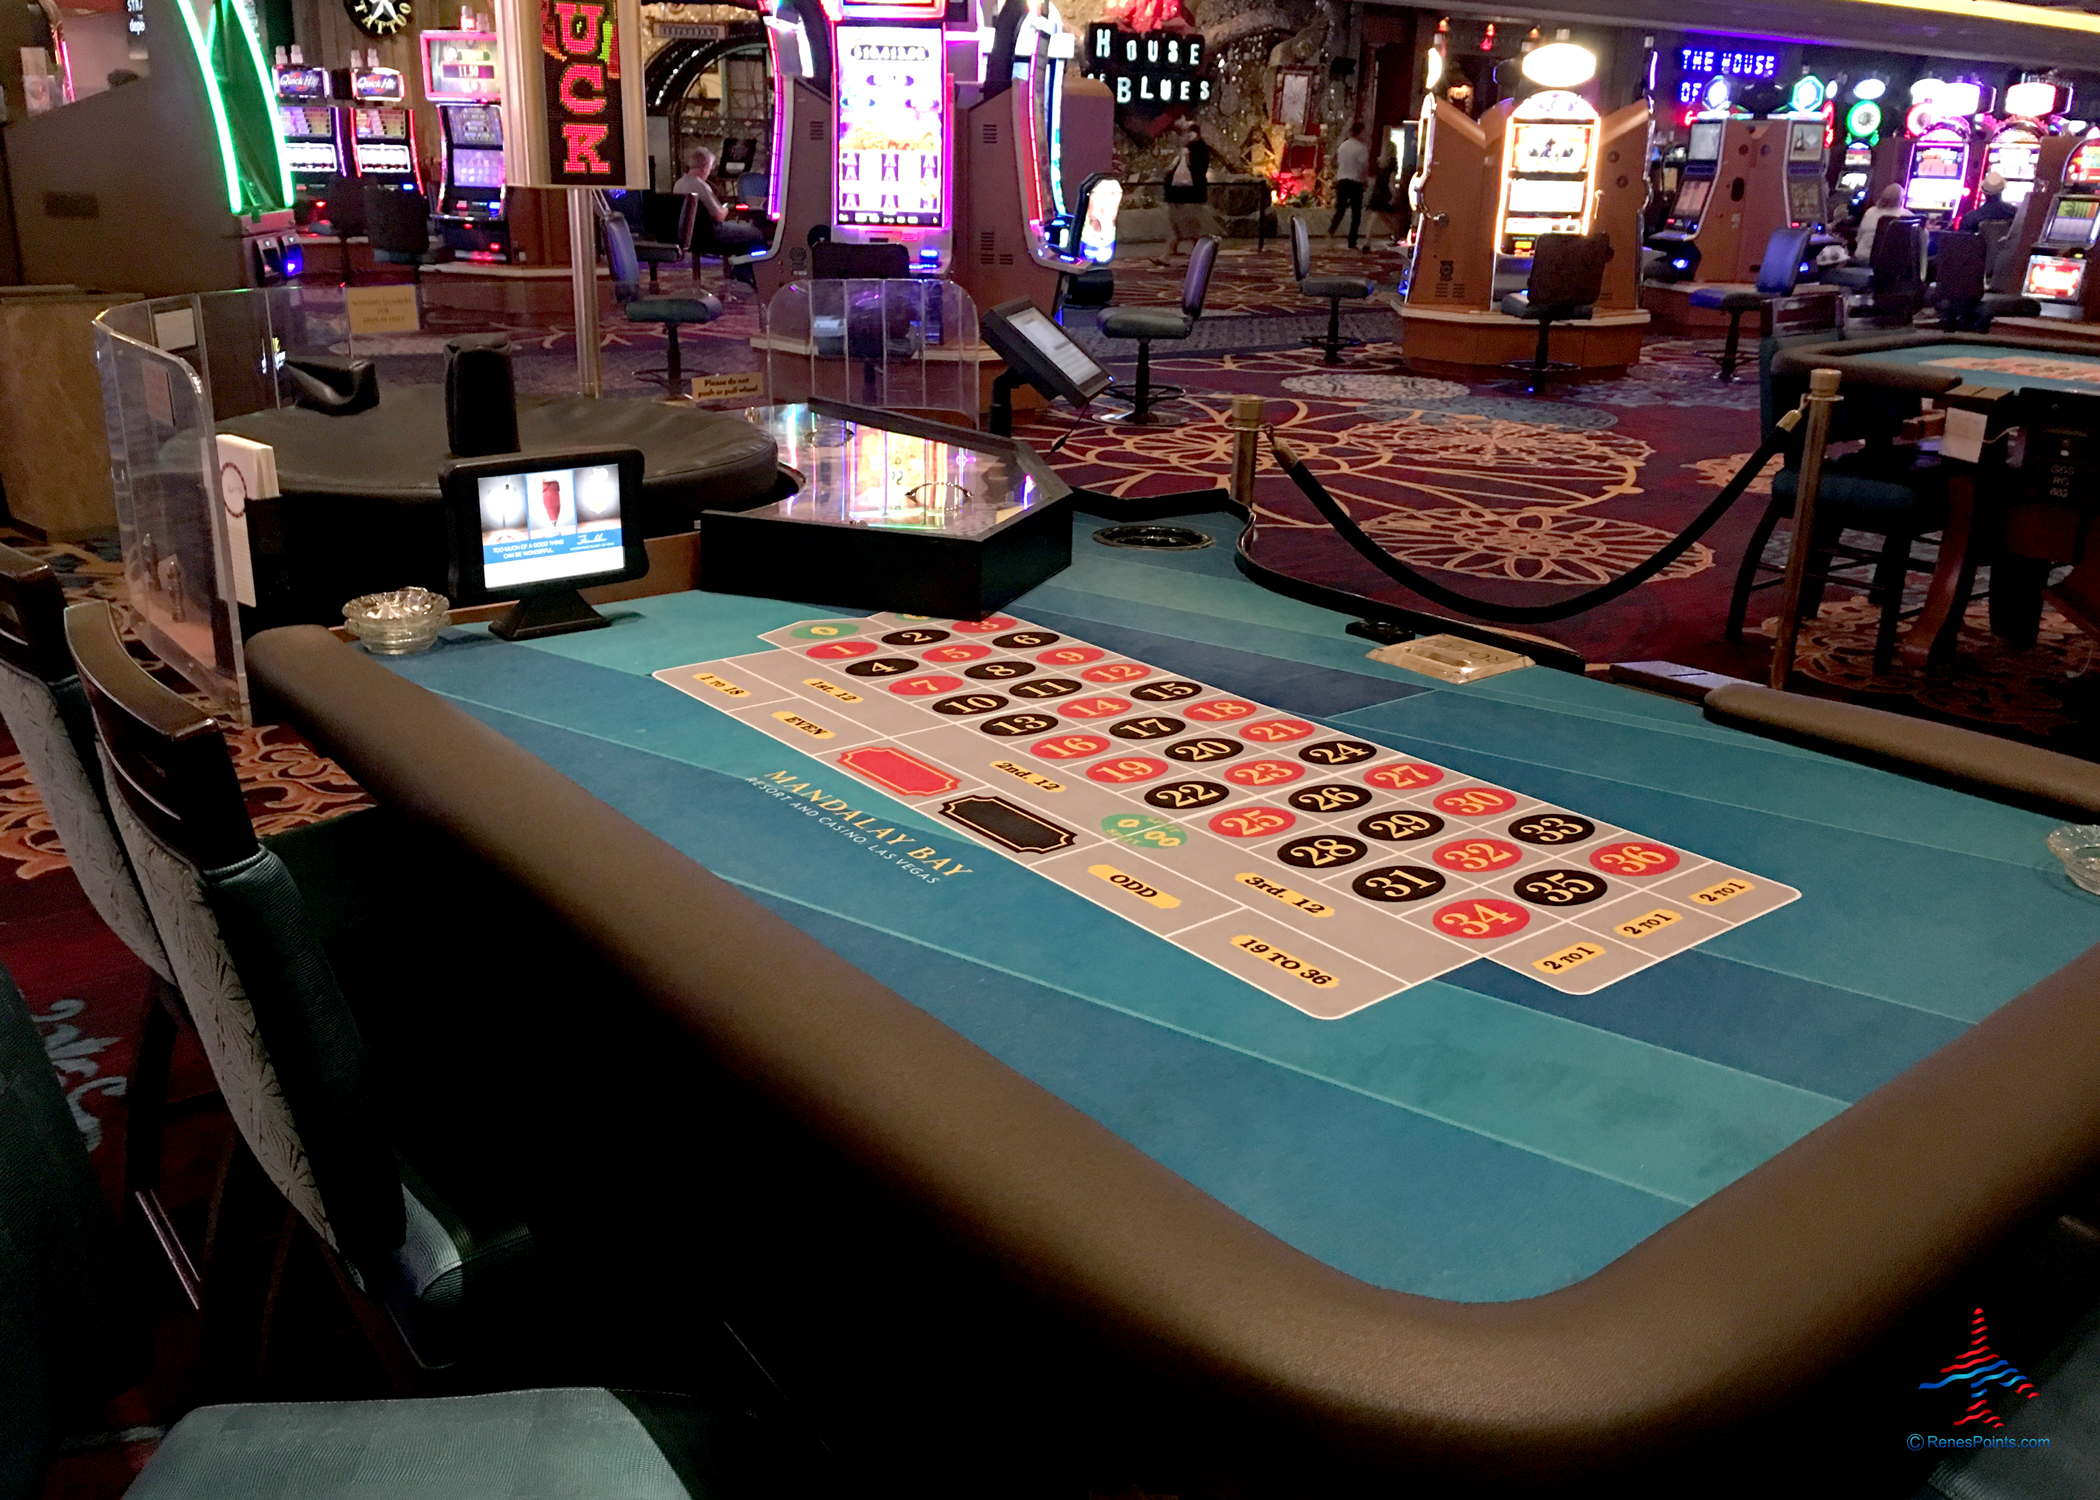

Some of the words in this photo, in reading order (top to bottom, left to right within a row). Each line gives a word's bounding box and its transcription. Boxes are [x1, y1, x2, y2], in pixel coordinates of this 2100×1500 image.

[1096, 28, 1200, 66] HOUSE
[1682, 49, 1714, 72] THE
[1721, 52, 1775, 75] HOUSE
[280, 74, 303, 86] Quick
[357, 77, 381, 89] Quick
[1117, 76, 1210, 104] BLUES
[1681, 82, 1702, 102] OF
[704, 379, 726, 387] Please
[901, 632, 932, 643] 2
[1013, 634, 1041, 645] 6
[829, 645, 856, 655] 1
[941, 648, 972, 659] 5
[1055, 651, 1085, 662] 9
[871, 662, 898, 673] 4
[985, 665, 1016, 676] 8
[1091, 665, 1143, 681] 12
[728, 686, 745, 696] 18
[810, 681, 831, 693] 1st.
[836, 692, 858, 702] 12
[910, 679, 939, 692] 7
[1020, 681, 1073, 697] 11
[1141, 683, 1194, 700] 15
[945, 696, 998, 714] 10
[1069, 699, 1125, 717] 14
[1193, 702, 1247, 720] 18
[784, 716, 828, 736] EVEN
[993, 716, 1047, 734] 13
[1119, 718, 1172, 738] 17
[1250, 722, 1306, 741] 21
[1036, 738, 1098, 757] 16
[1174, 741, 1231, 761] 20
[1309, 743, 1370, 763] 24
[995, 762, 1029, 780] 2nd.
[1034, 779, 1061, 791] 12
[1096, 761, 1153, 781] 19
[1234, 763, 1293, 785] 23
[1373, 765, 1430, 788] 27
[1155, 784, 1220, 807] 22
[1298, 787, 1359, 811] 26
[1443, 791, 1504, 814] 30
[745, 777, 793, 802] RESORT
[789, 801, 820, 817] AND
[868, 844, 898, 860] LAS
[896, 858, 941, 884] VEGAS
[763, 770, 916, 845] MANDALAY
[906, 846, 973, 877] BAY
[1221, 809, 1284, 836] 25
[1369, 814, 1431, 839] 29
[1519, 817, 1584, 842] 33
[1290, 839, 1356, 866] 28
[1443, 843, 1514, 870] 32
[1599, 846, 1667, 873] 36
[1109, 874, 1158, 898] ODD
[1365, 869, 1436, 897] 31
[1526, 872, 1595, 903] 35
[1244, 876, 1284, 899] 3rd.
[1292, 898, 1325, 914] 12
[1699, 893, 1717, 903] 2
[1715, 886, 1733, 898] TO
[1440, 903, 1518, 935] 34
[1623, 925, 1642, 937] 2
[1640, 918, 1660, 930] TO
[1239, 938, 1270, 954] 19
[1268, 952, 1300, 970] TO
[1299, 969, 1332, 985] 36
[1544, 959, 1564, 971] 2
[1563, 952, 1582, 964] TO
